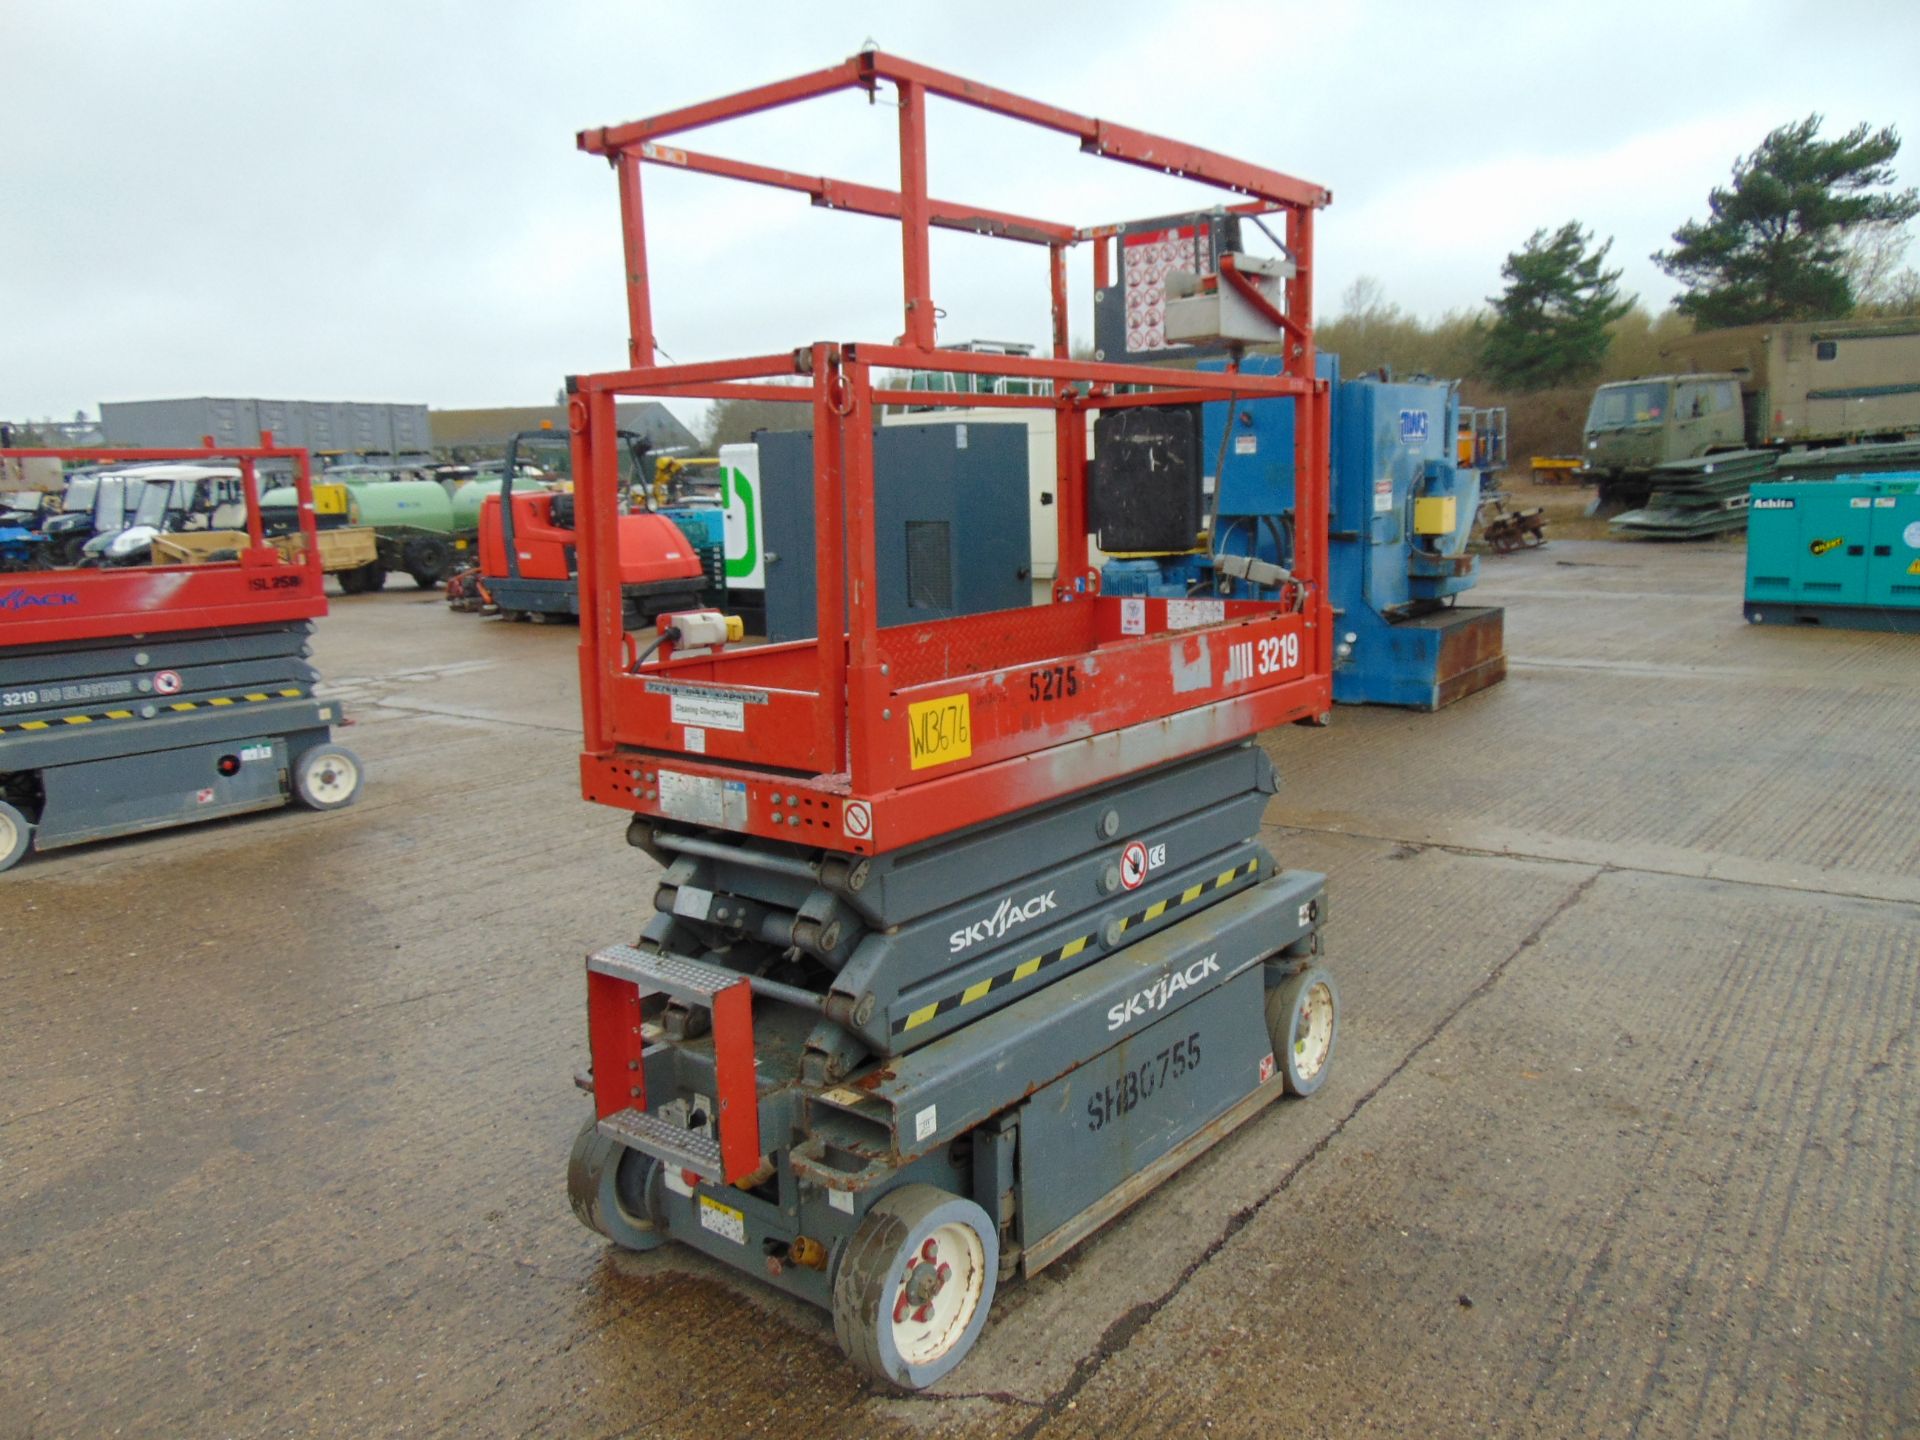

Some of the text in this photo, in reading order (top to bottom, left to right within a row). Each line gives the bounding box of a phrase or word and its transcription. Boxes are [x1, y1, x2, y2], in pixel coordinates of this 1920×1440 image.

[1258, 632, 1299, 675] 3219
[2, 691, 38, 706] 3219
[1030, 666, 1078, 703] 5275
[949, 889, 1058, 953] SKYJACK
[1107, 951, 1221, 1032] SKYJACK
